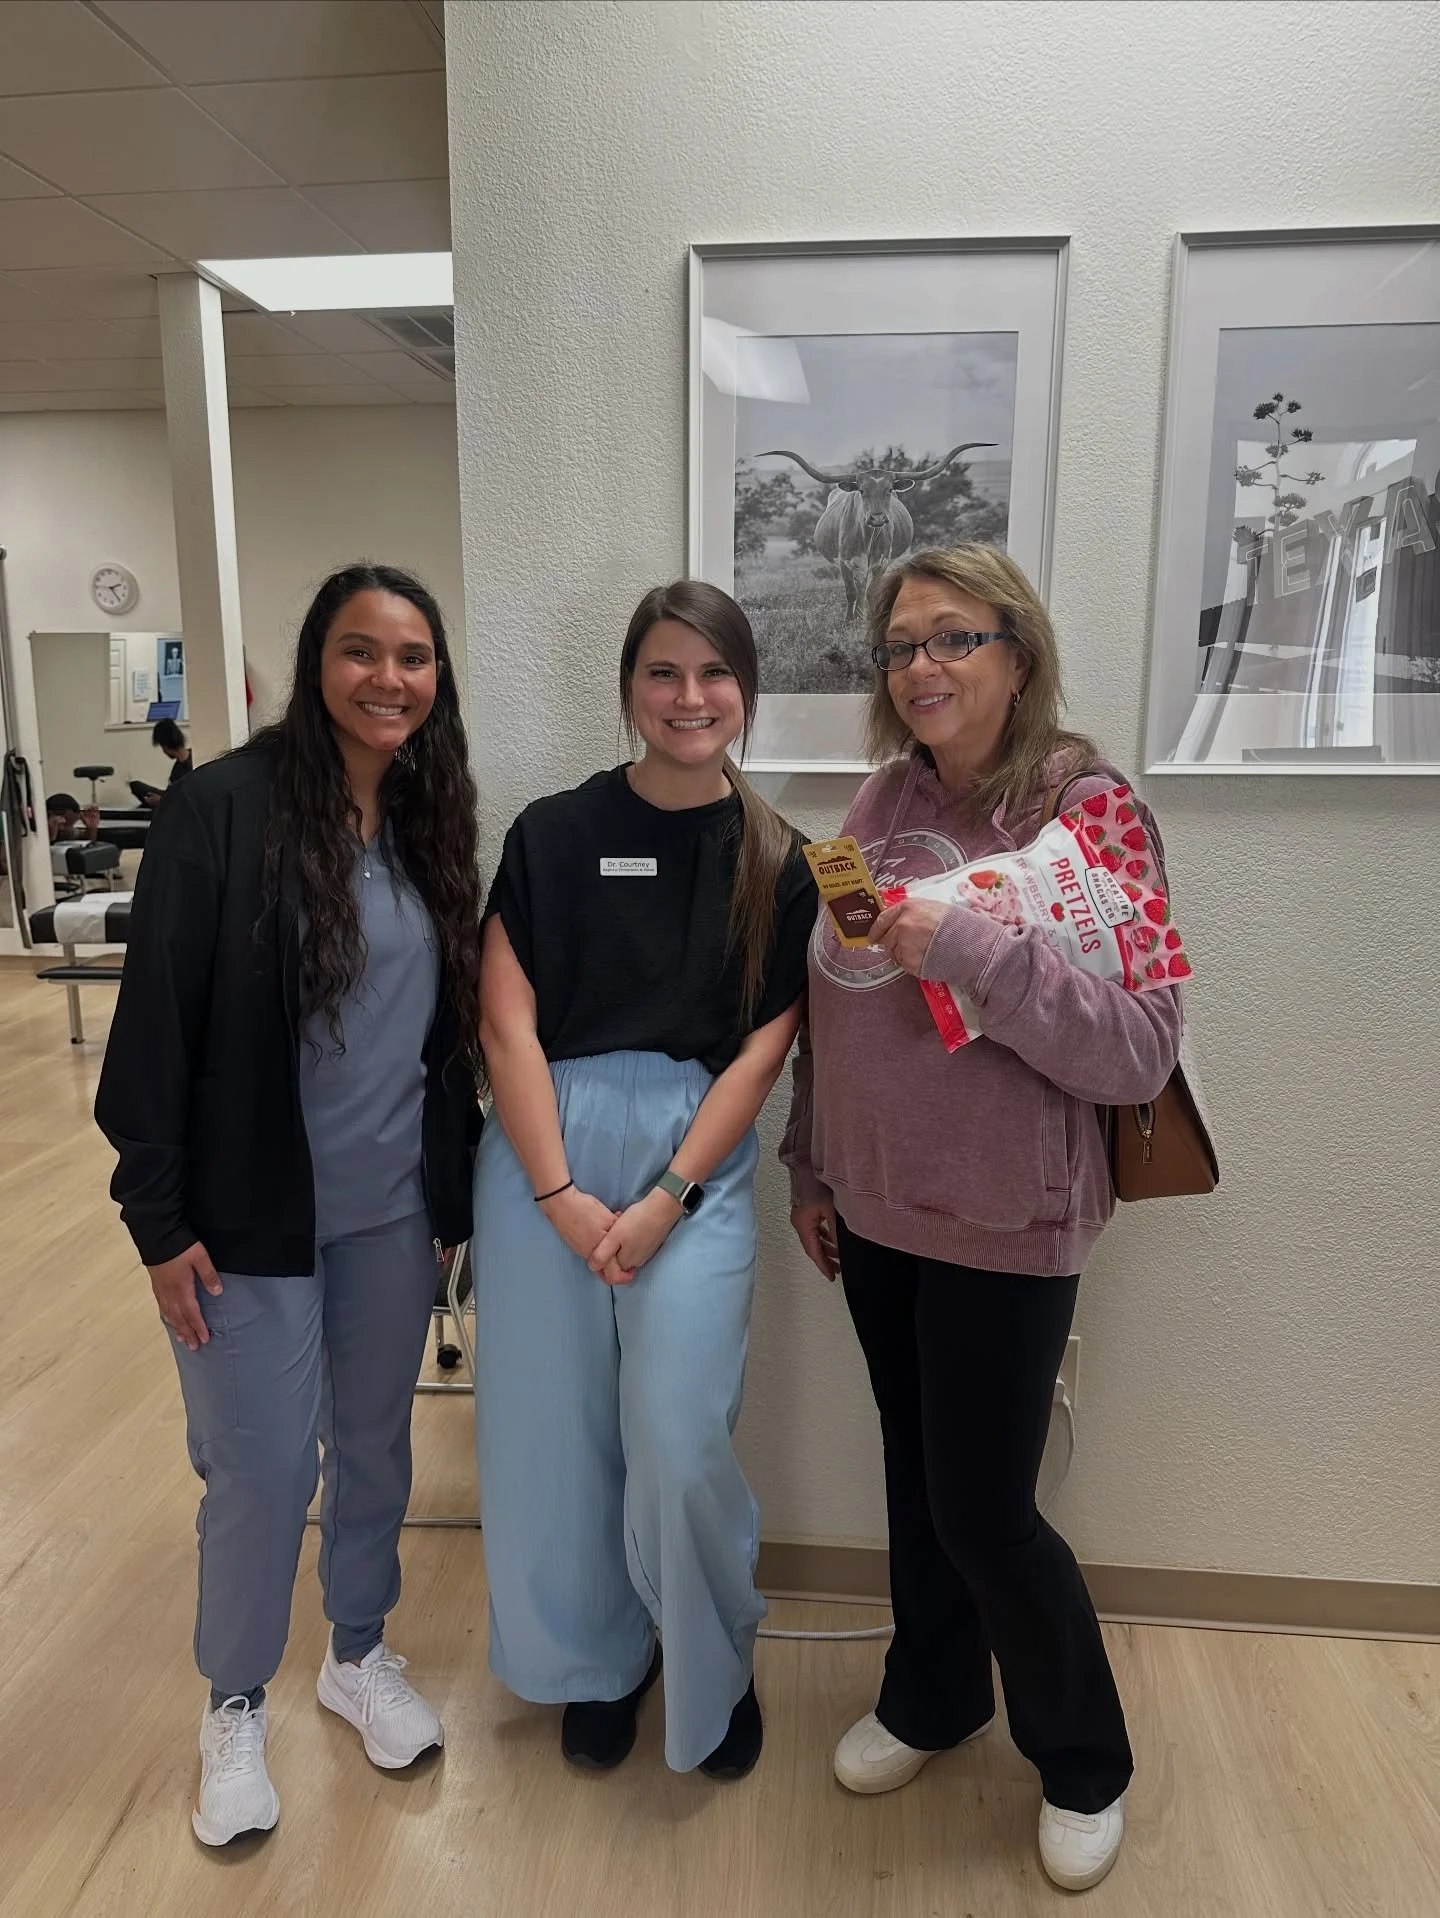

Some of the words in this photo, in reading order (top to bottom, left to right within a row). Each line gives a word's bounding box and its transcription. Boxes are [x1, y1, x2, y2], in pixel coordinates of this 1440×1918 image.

[1237, 475, 1440, 607] TEXA
[619, 861, 650, 869] Courtney
[818, 861, 858, 875] OUTBACK
[1016, 856, 1052, 923] TRAWBERRY
[1050, 857, 1101, 954] PRETZELS
[1091, 872, 1109, 907] SNACKS
[1103, 871, 1129, 917] CREATIVE
[846, 912, 873, 921] OUTBACK
